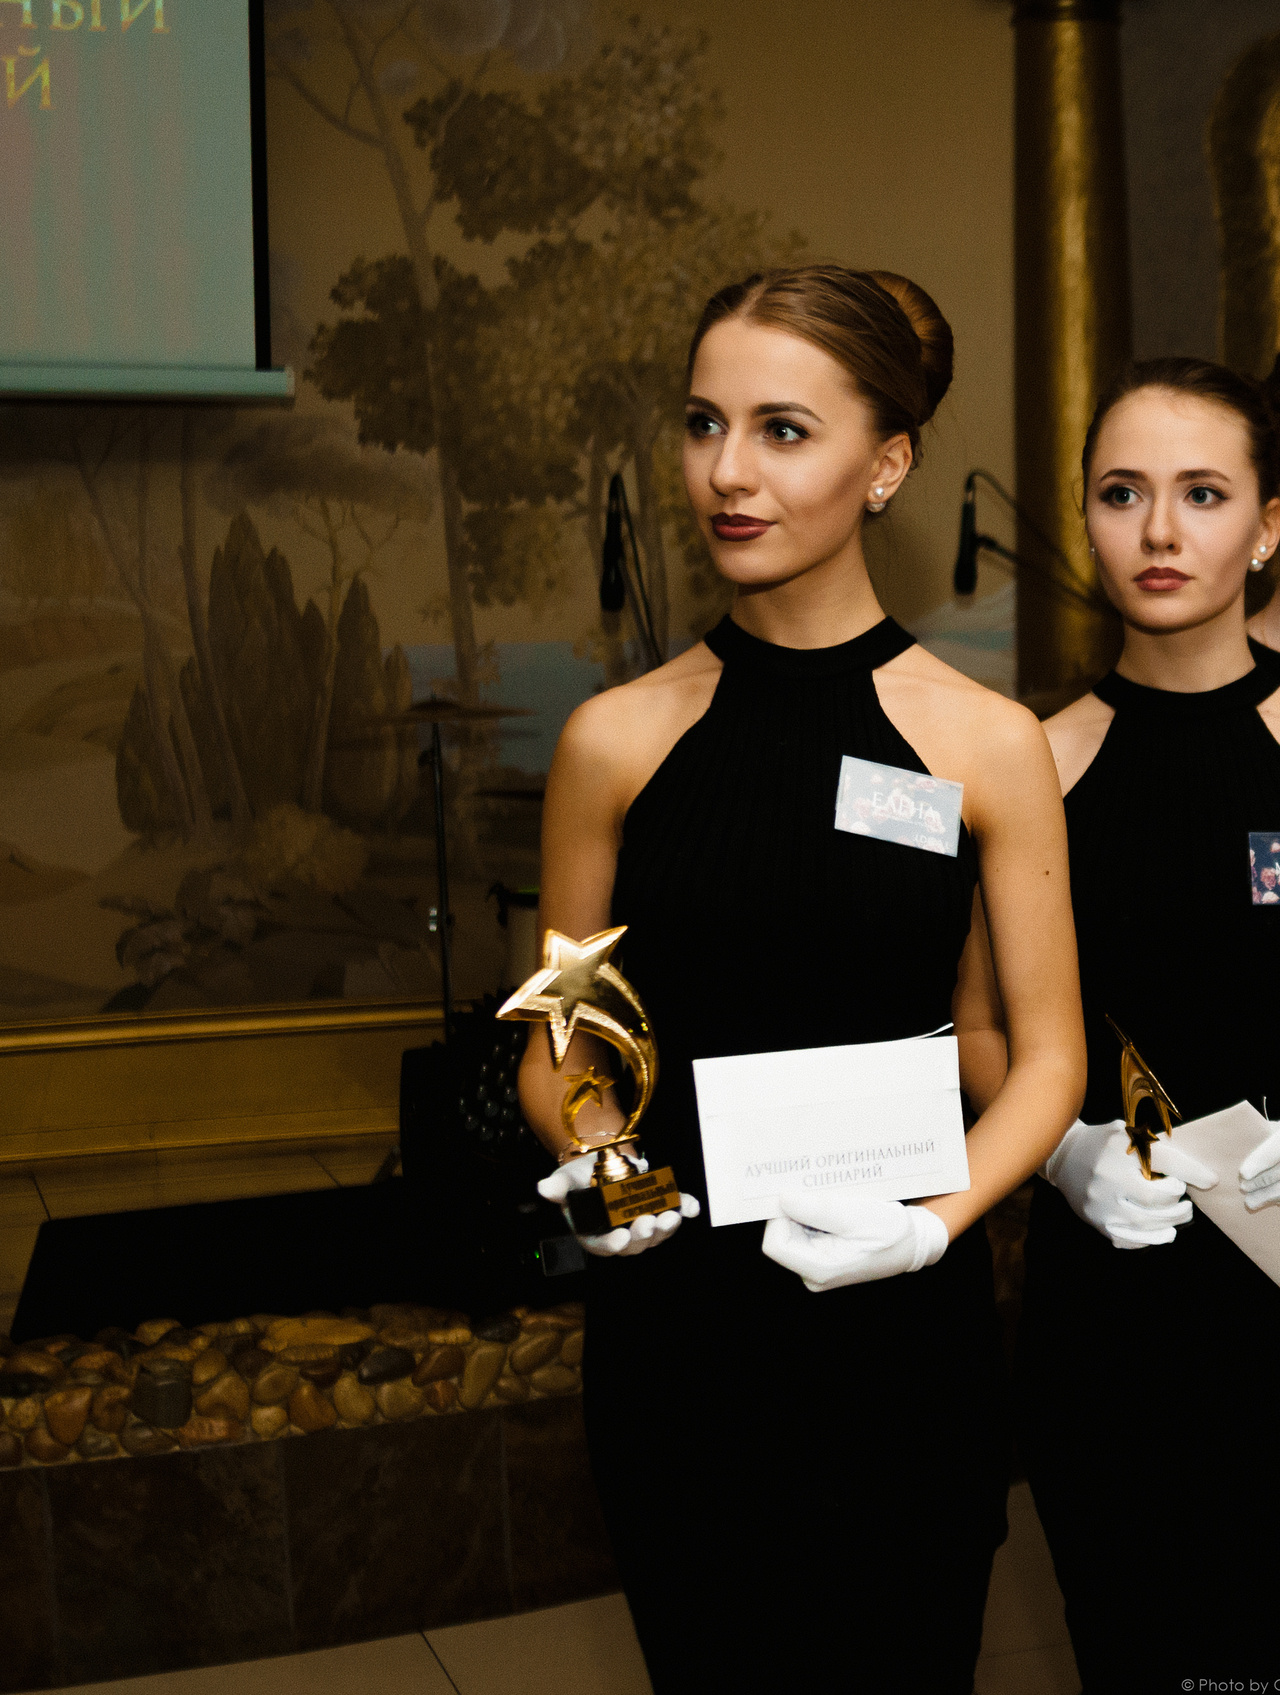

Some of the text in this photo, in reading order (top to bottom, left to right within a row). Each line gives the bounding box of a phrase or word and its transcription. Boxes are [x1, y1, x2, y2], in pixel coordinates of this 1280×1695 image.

[744, 1140, 936, 1179] ЛУЧШИЙ ОРИГИНАЛЬНЫЙ
[802, 1163, 884, 1188] СЦЕНАРИЙ
